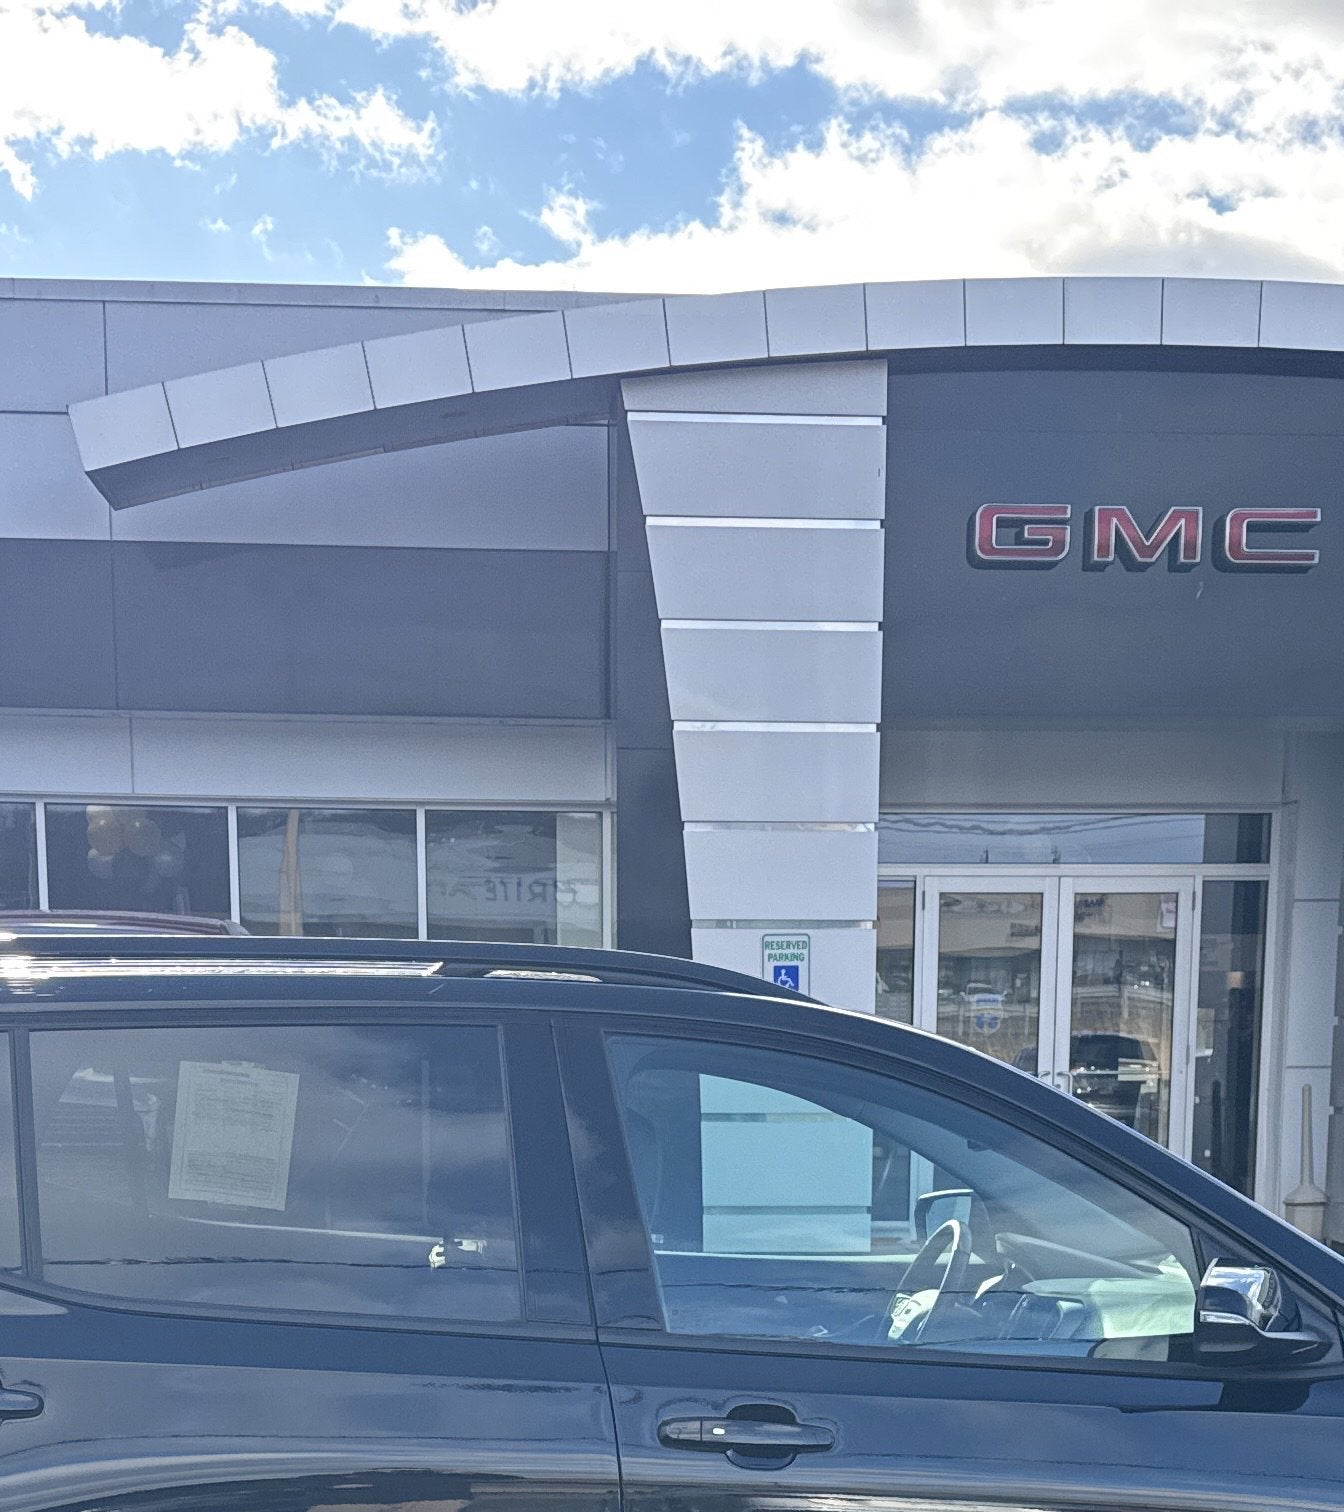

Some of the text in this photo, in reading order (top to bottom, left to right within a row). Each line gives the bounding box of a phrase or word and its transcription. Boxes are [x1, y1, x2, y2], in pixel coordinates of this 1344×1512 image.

[973, 503, 1322, 565] GMC
[764, 940, 808, 950] RESERVED
[767, 952, 805, 962] PARKING
